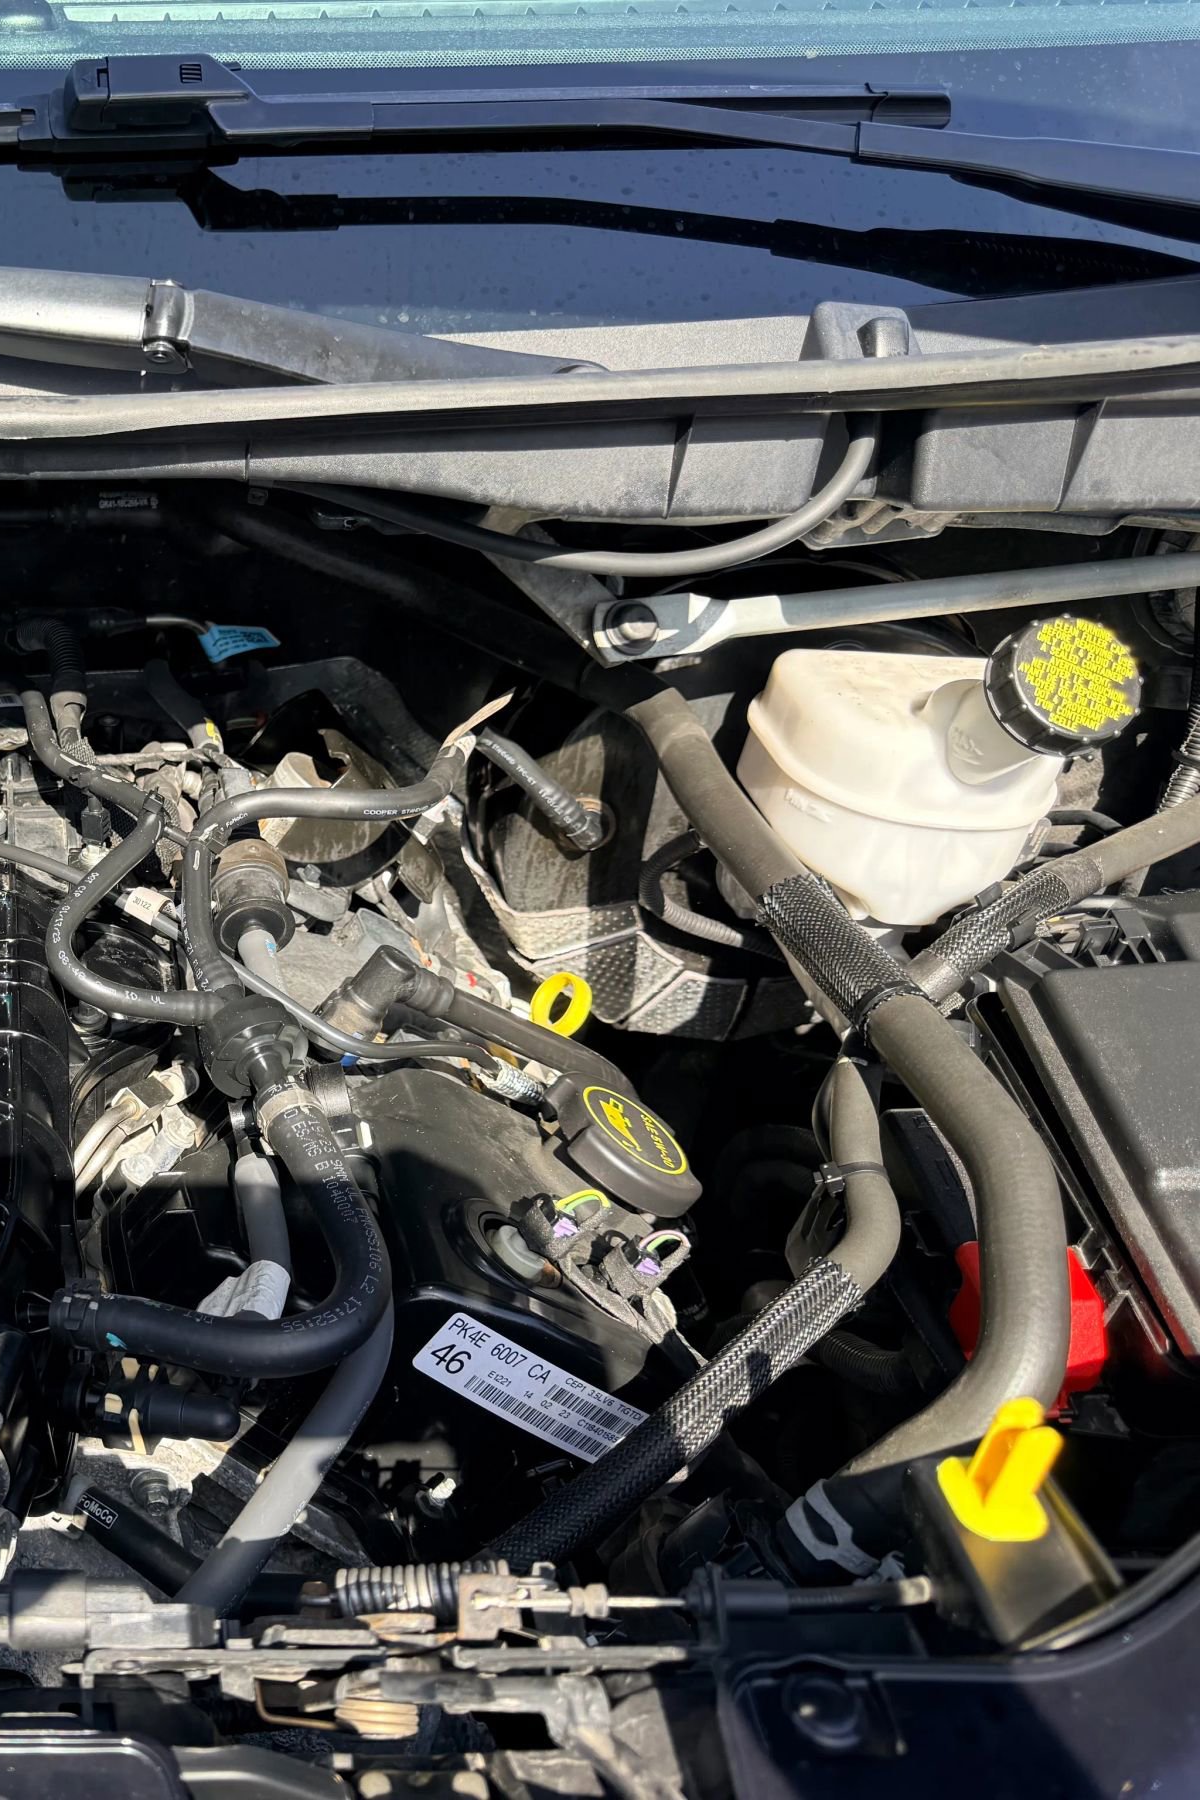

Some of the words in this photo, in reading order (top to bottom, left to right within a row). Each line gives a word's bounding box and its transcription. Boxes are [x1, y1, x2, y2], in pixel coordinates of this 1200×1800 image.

[1041, 624, 1073, 644] BEFORE
[1117, 656, 1135, 670] USE
[1053, 619, 1080, 638] CLEAN
[1081, 632, 1108, 650] FILLER
[1036, 631, 1058, 647] ONLY
[1059, 641, 1076, 655] DOT
[1077, 648, 1086, 658] 4
[1085, 652, 1111, 669] FLUID
[1111, 664, 1134, 680] FROM
[1039, 642, 1048, 653] A
[1048, 646, 1079, 666] SEALED
[1017, 662, 1044, 680] AVANT
[1045, 673, 1058, 685] DE
[1059, 679, 1072, 691] LE
[1030, 658, 1071, 682] NETTOYER
[1072, 675, 1085, 687] LE
[1025, 675, 1055, 694] PLOYER
[1057, 688, 1074, 701] QUE
[1075, 695, 1088, 707] DU
[1033, 687, 1050, 701] DOT
[1051, 694, 1061, 705] 4
[1060, 699, 1106, 724] PROVENANT
[1055, 706, 1101, 731] CONTENANT
[640, 1115, 658, 1134] SAE
[651, 1134, 675, 1168] 5W-30
[314, 1160, 330, 1172] B
[281, 1295, 364, 1333] 17:52:55
[426, 1341, 474, 1376] 46
[446, 1318, 492, 1349] PK4E
[489, 1343, 528, 1370] 6007
[525, 1363, 552, 1384] CA
[522, 1390, 534, 1400] 14
[539, 1399, 553, 1410] 02
[557, 1408, 571, 1419] 23
[78, 1493, 114, 1525] FoMoCo
